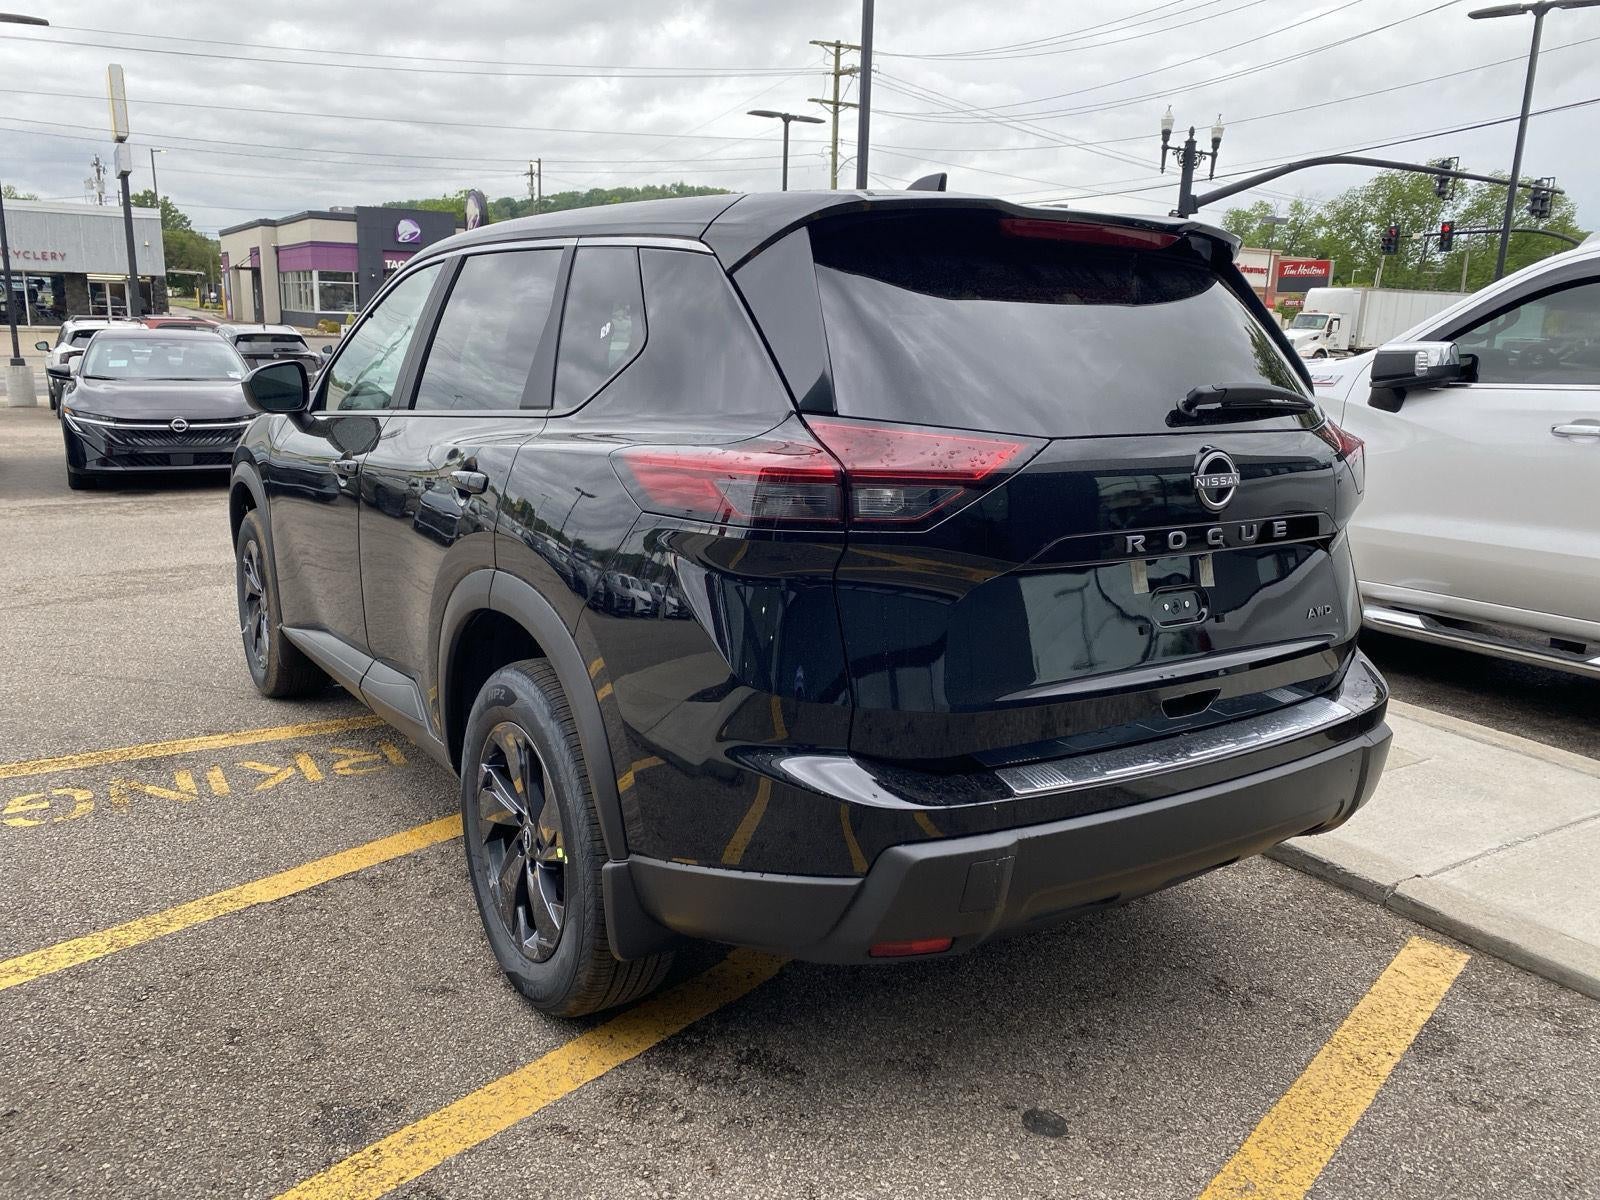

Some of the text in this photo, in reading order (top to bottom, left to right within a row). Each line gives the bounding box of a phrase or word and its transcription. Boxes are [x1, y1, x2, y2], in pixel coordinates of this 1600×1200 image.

[1, 249, 67, 261] YCLERY
[384, 259, 406, 269] TAC
[1283, 263, 1325, 276] Tim Hortons
[1196, 475, 1240, 488] NISSAN
[1126, 520, 1288, 553] ROGUE
[1306, 604, 1332, 619] AWD
[2, 740, 411, 829] RKING
